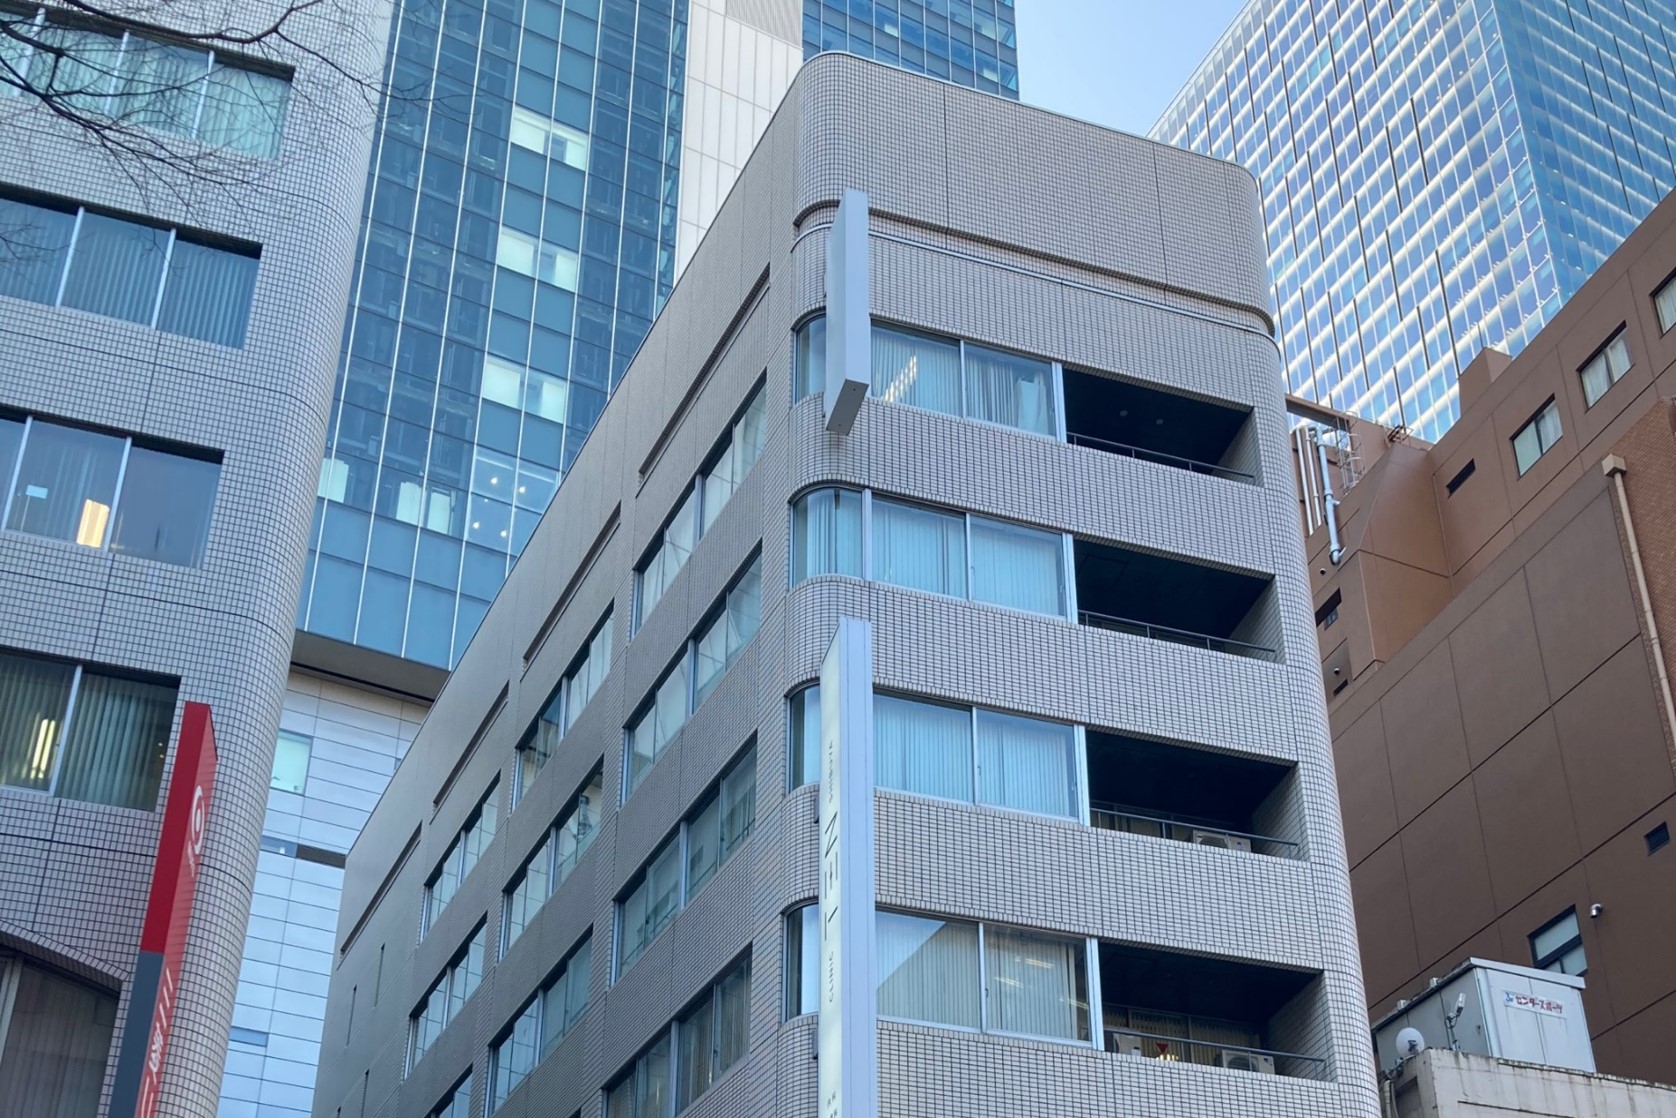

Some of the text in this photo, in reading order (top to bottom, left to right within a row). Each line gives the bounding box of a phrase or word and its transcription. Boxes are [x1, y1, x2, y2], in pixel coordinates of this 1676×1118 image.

[1515, 994, 1563, 1014] センタースポーツ
